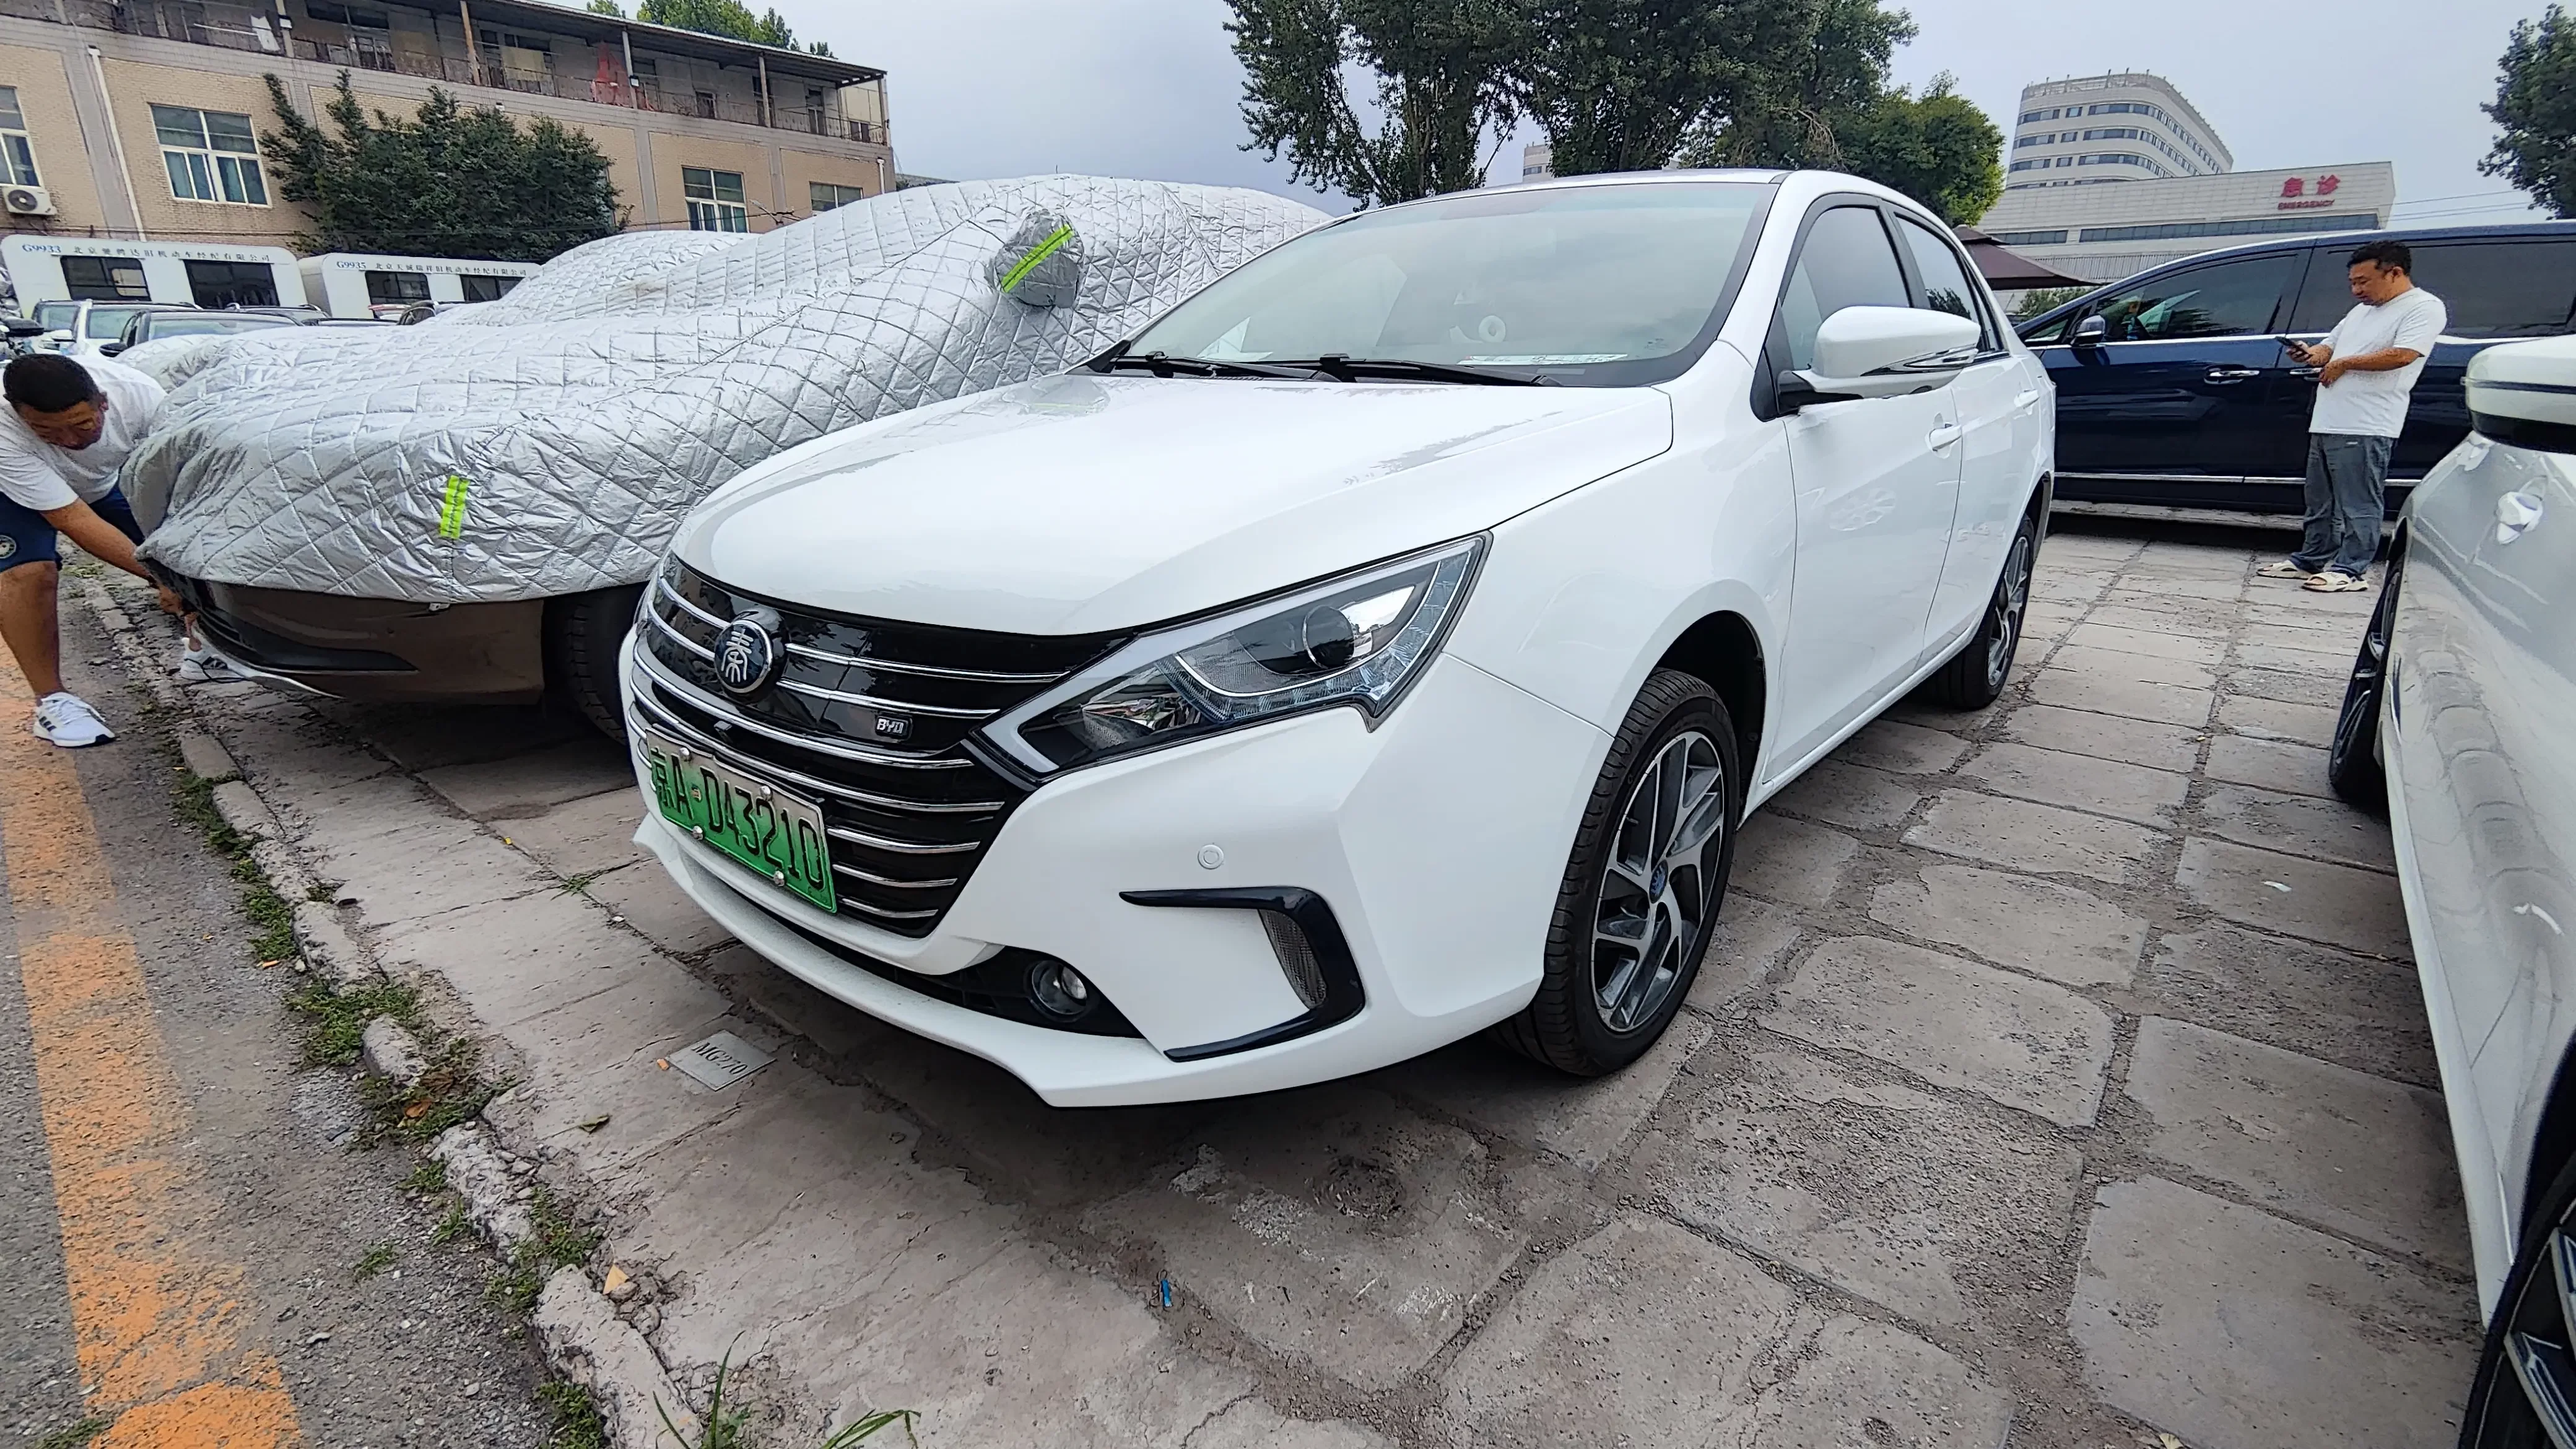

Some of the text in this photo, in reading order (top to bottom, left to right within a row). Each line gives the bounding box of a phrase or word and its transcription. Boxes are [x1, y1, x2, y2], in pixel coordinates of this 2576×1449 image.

[2282, 175, 2341, 198] 急诊
[2278, 199, 2335, 210] EMERGENCY
[22, 244, 61, 253] G9933
[336, 261, 367, 269] G9935
[876, 718, 904, 734] BYD
[691, 1042, 748, 1075] MG270
